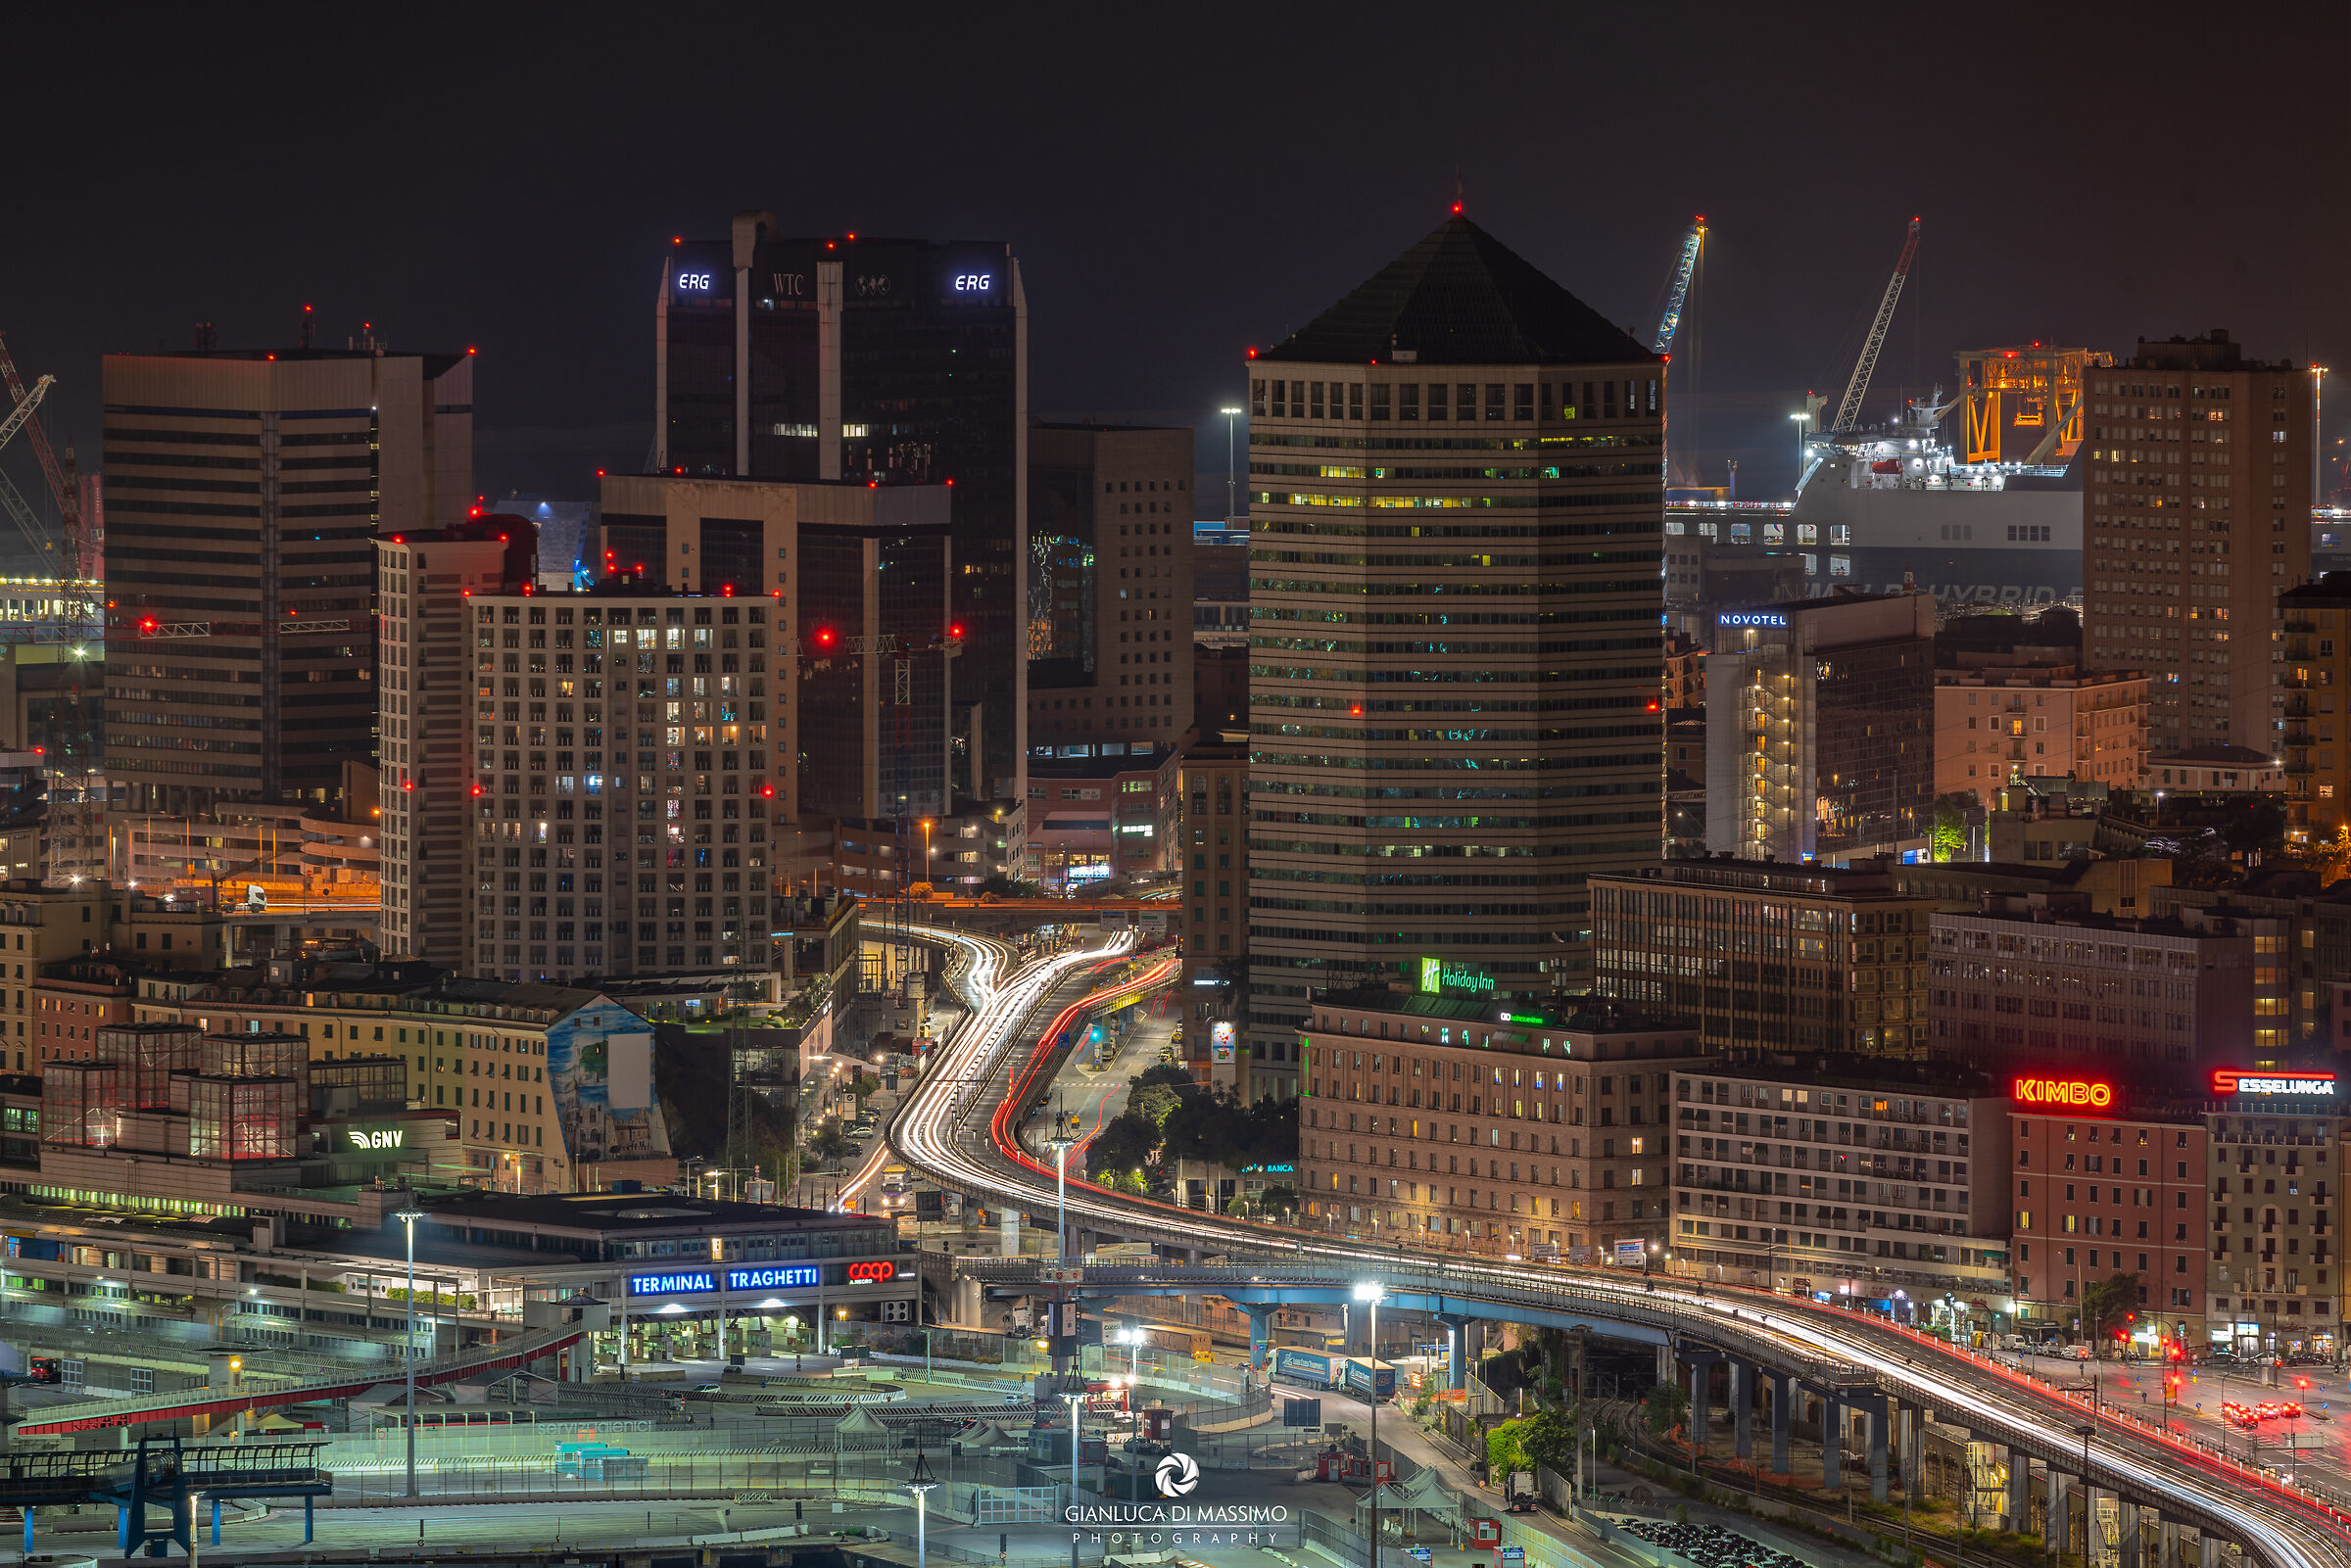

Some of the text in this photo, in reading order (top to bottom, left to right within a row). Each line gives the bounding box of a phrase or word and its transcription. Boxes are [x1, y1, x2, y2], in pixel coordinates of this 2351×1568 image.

[678, 273, 710, 290] ERG
[773, 273, 804, 296] WTC
[954, 274, 990, 291] ERG
[1720, 614, 1787, 625] NOVOTEL
[1442, 968, 1494, 993] Holiday Inn
[2016, 1079, 2111, 1106] KIMBO
[371, 1130, 403, 1149] GNV
[633, 1268, 817, 1293] TERMINAL TRAGHETTI
[848, 1260, 893, 1283] coop
